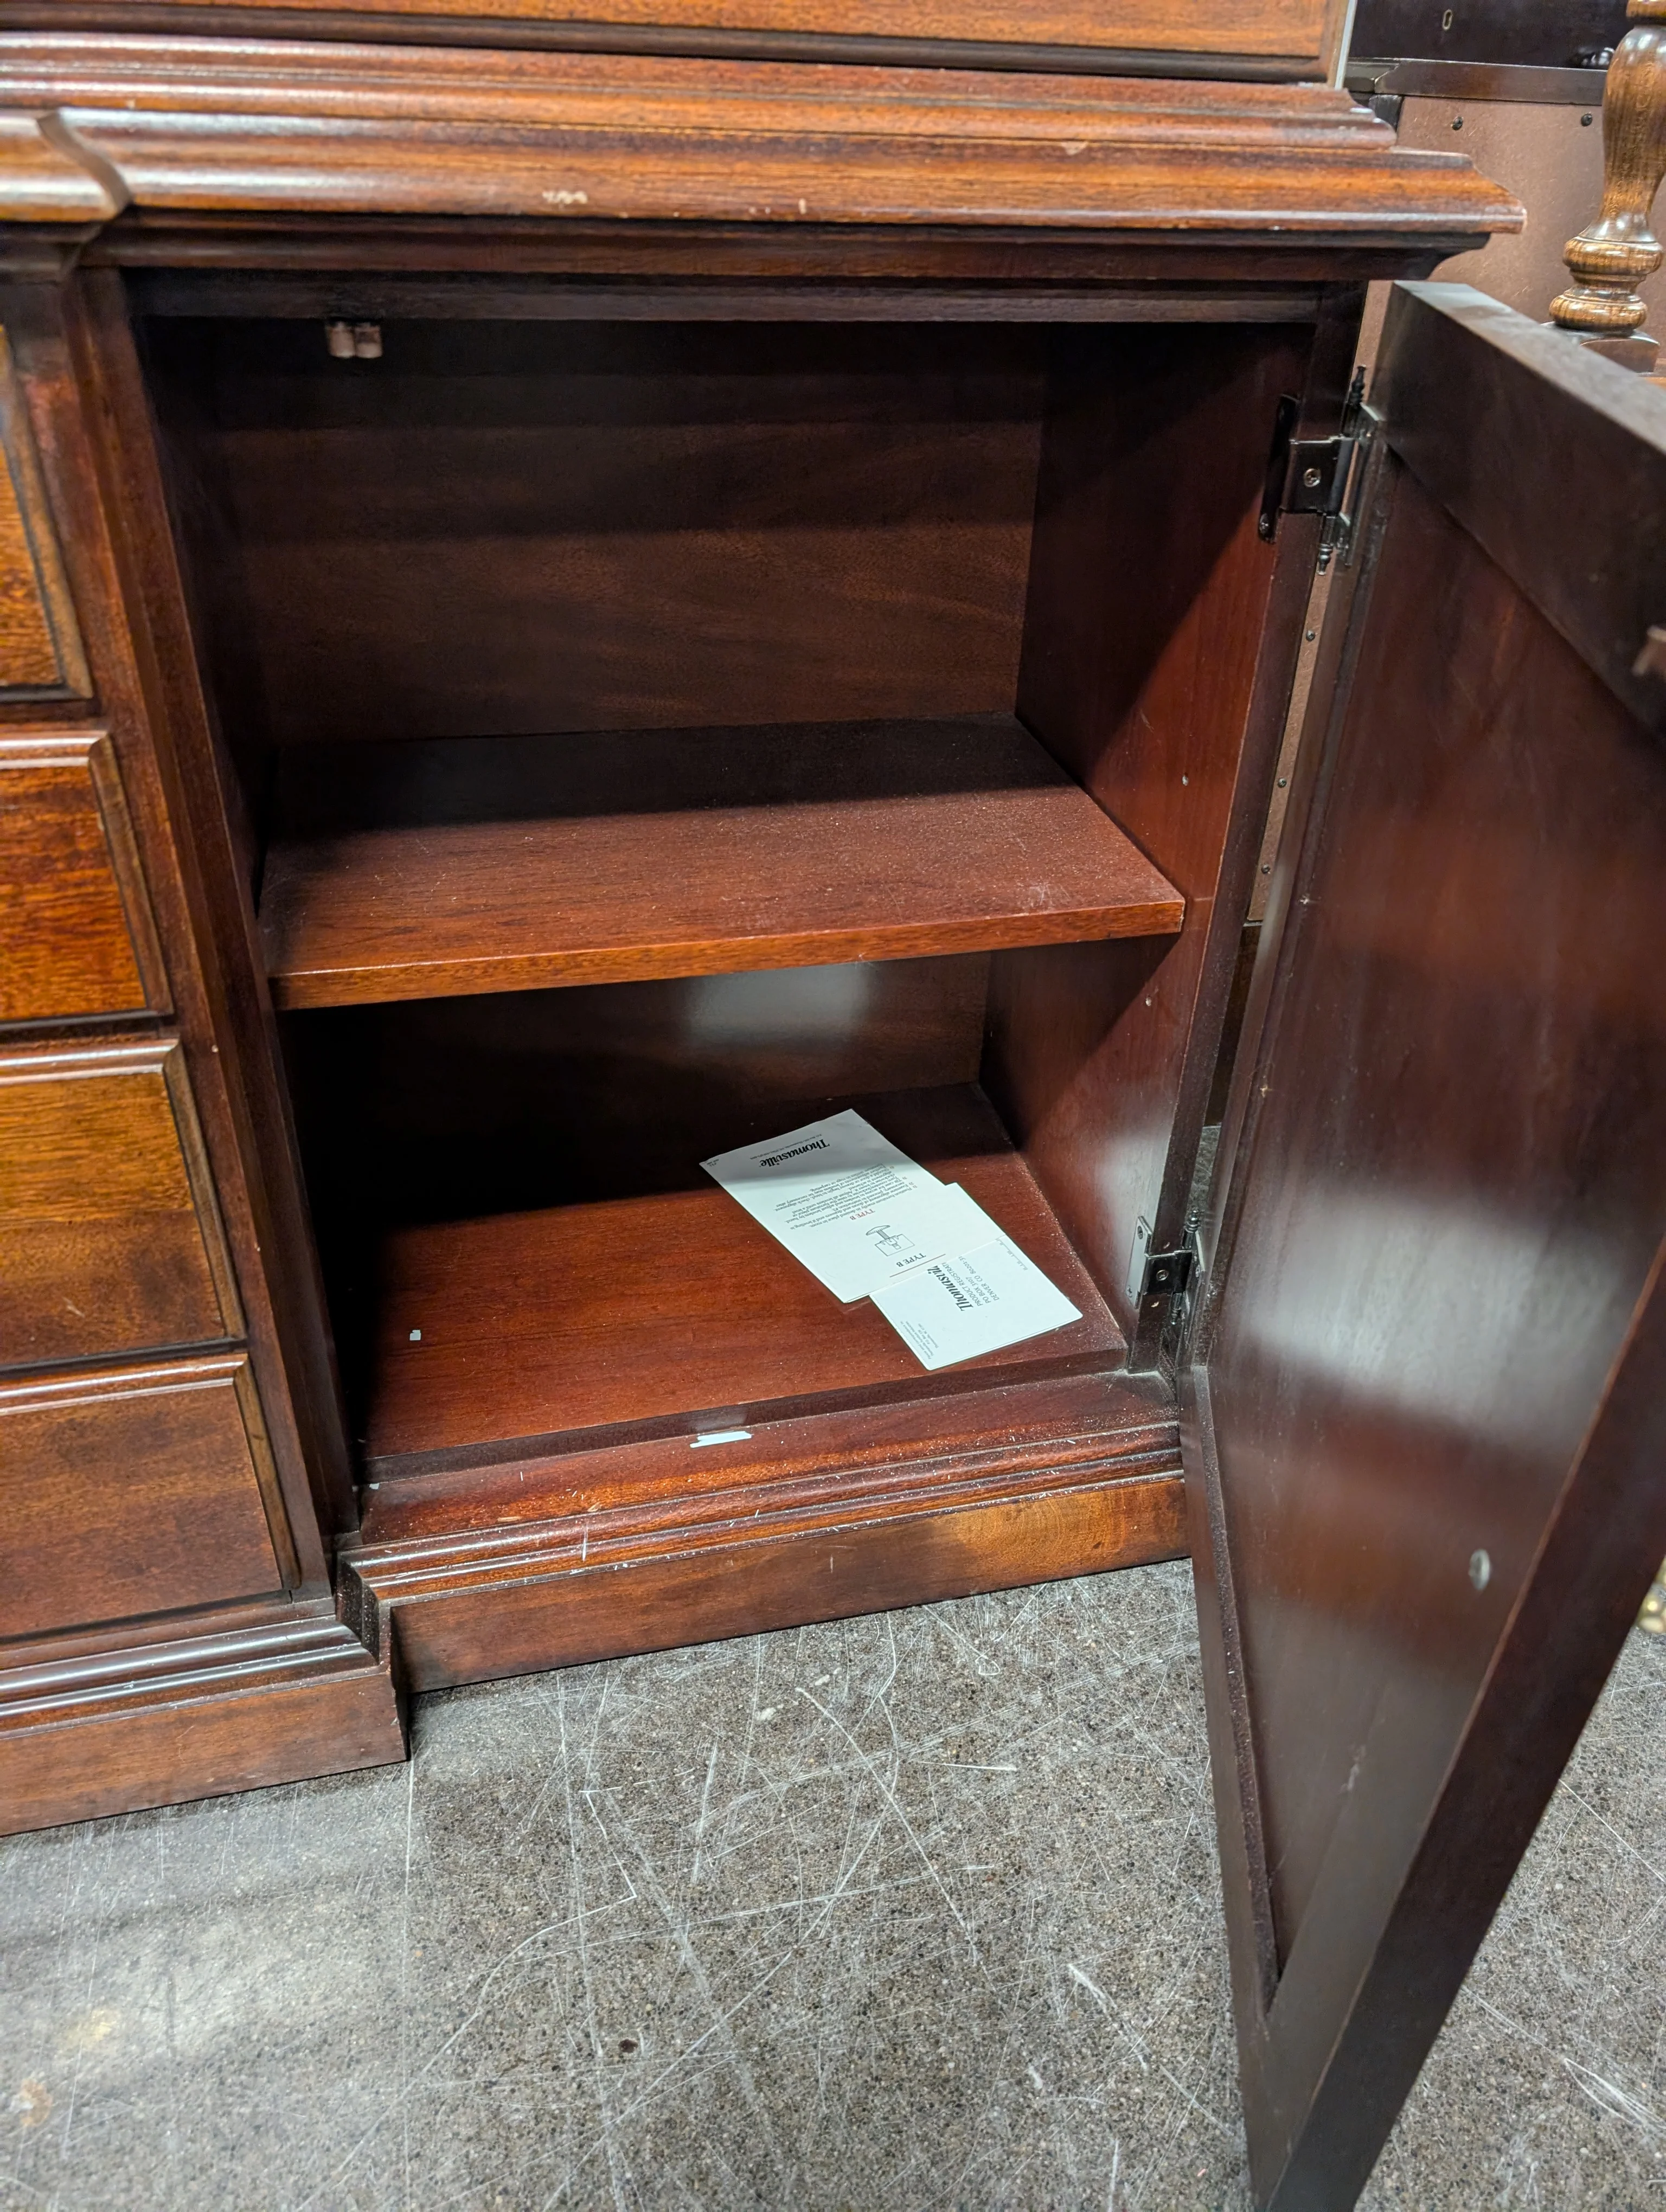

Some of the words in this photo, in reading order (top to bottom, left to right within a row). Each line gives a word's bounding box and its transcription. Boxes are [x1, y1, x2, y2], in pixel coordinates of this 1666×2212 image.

[760, 1139, 830, 1167] Thomasville
[855, 1209, 875, 1218] TYPE
[903, 1253, 926, 1264] TYPE
[966, 1277, 978, 1286] 3107
[962, 1287, 983, 1306] PRODUCT
[974, 1287, 985, 1296] BOX
[981, 1283, 999, 1301] DENVER
